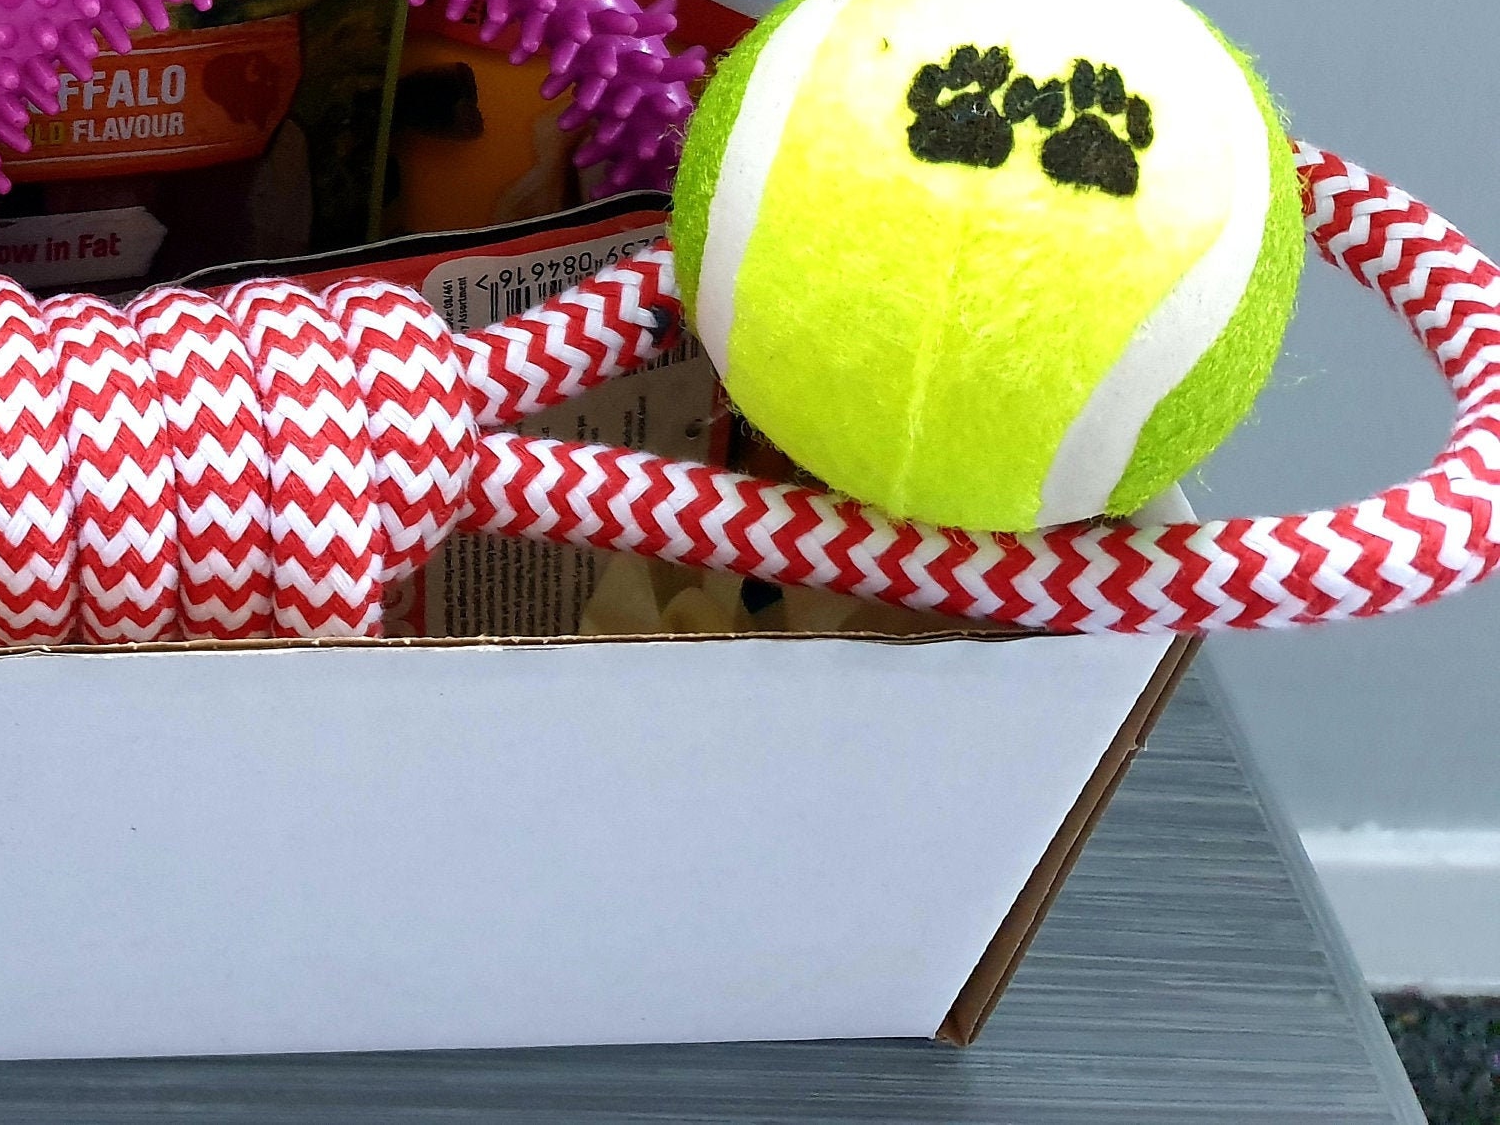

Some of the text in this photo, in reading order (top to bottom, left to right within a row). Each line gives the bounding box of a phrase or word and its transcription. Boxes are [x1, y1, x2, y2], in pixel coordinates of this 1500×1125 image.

[26, 64, 187, 114] FFALO
[72, 112, 185, 143] FLAVOUR
[46, 236, 70, 262] in
[77, 231, 122, 258] Fat
